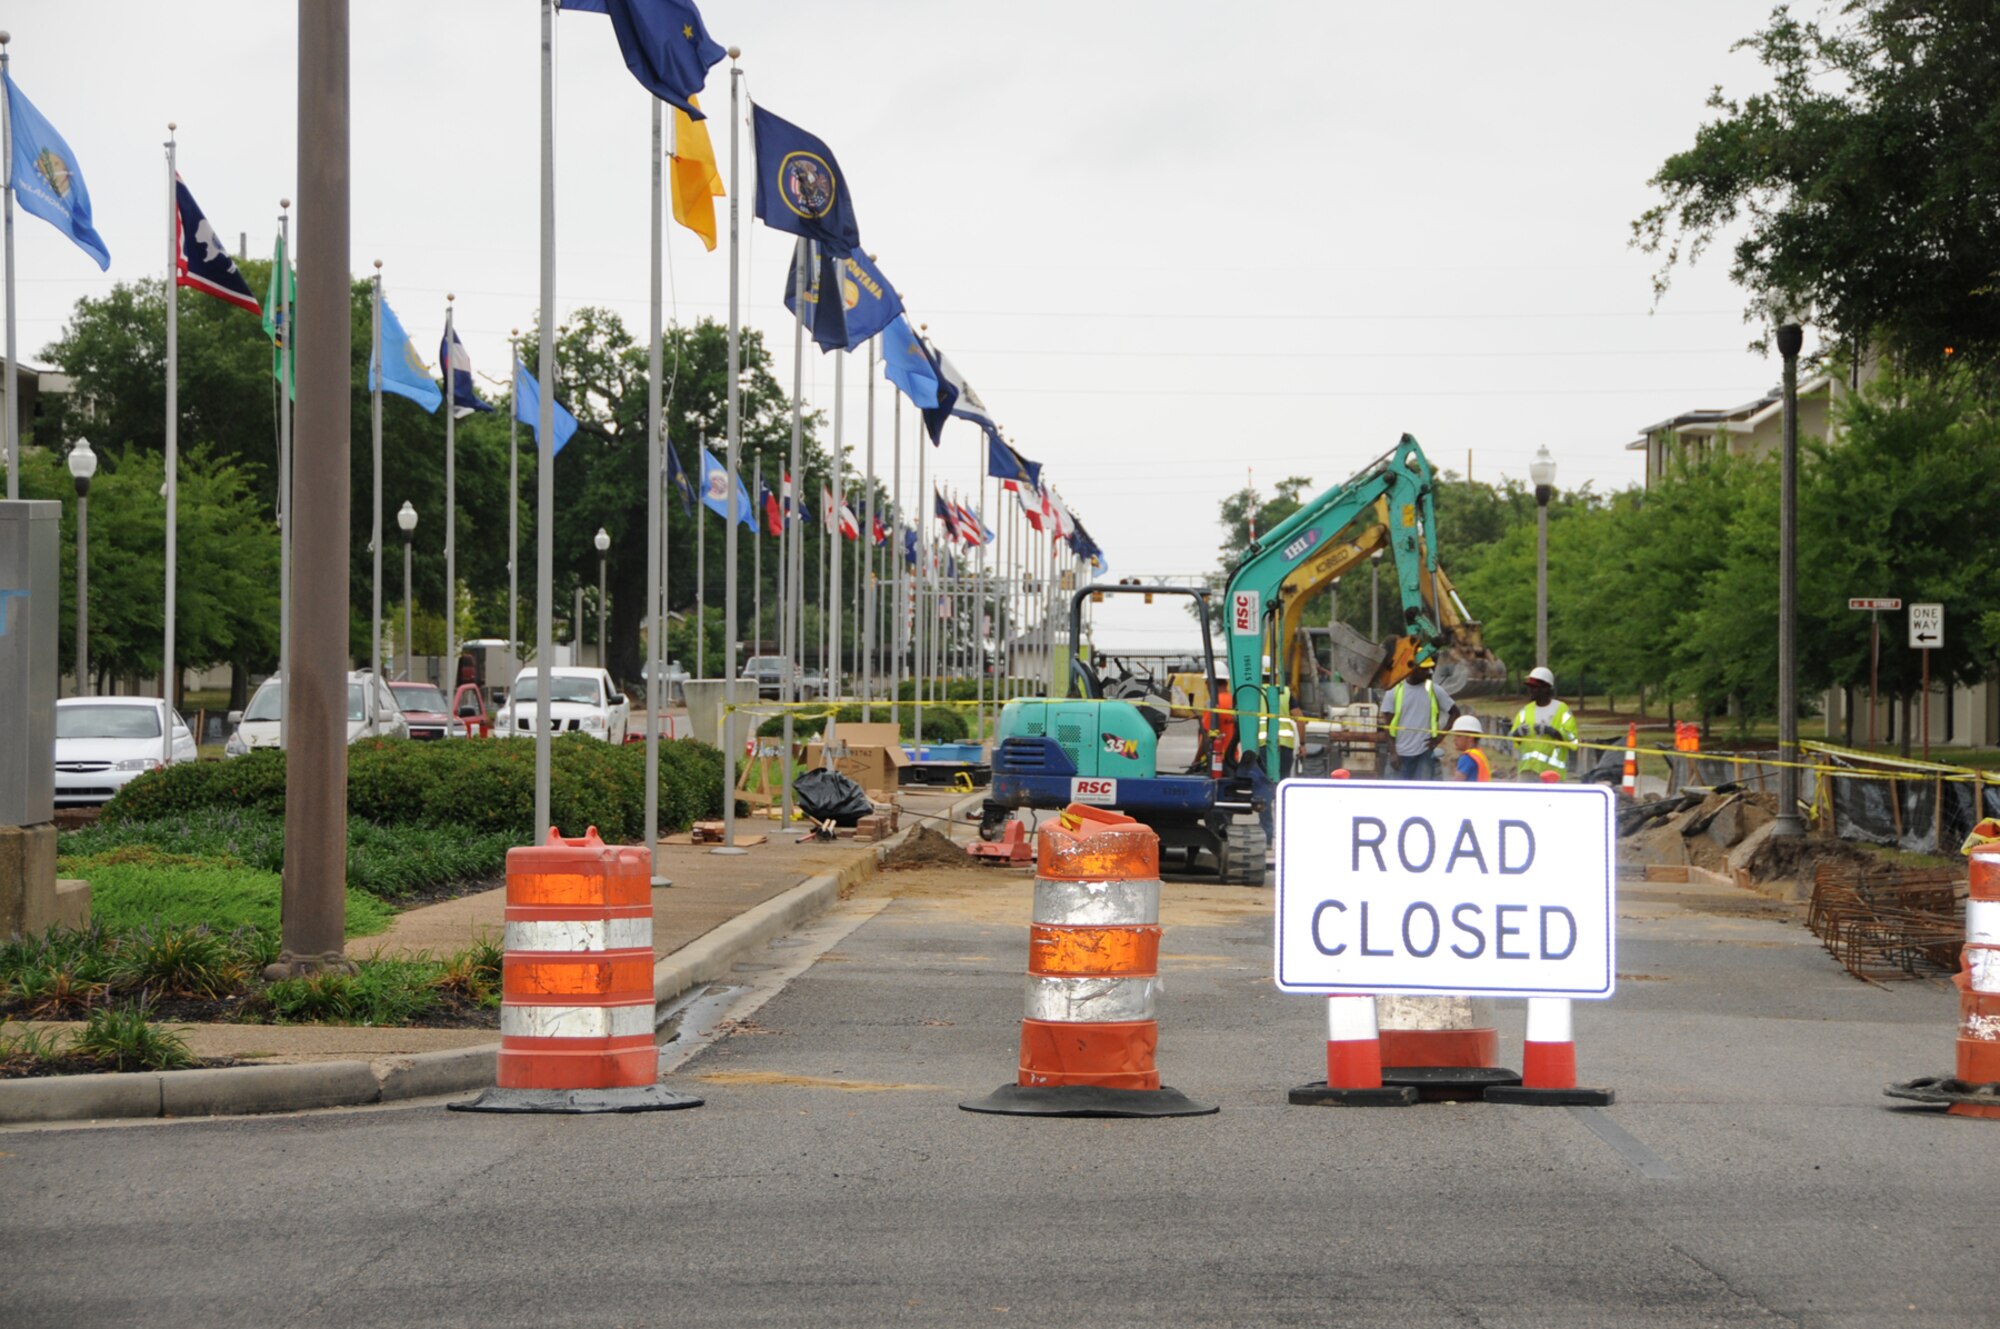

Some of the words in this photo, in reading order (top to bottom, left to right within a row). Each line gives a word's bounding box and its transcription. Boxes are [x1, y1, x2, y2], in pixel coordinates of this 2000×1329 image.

[1236, 595, 1249, 630] RSC
[1913, 608, 1938, 619] ONE
[1913, 620, 1938, 630] WAY
[1104, 739, 1138, 753] 35N
[1077, 781, 1112, 794] RSC
[1352, 816, 1536, 874] ROAD
[1311, 899, 1577, 960] CLOSED
